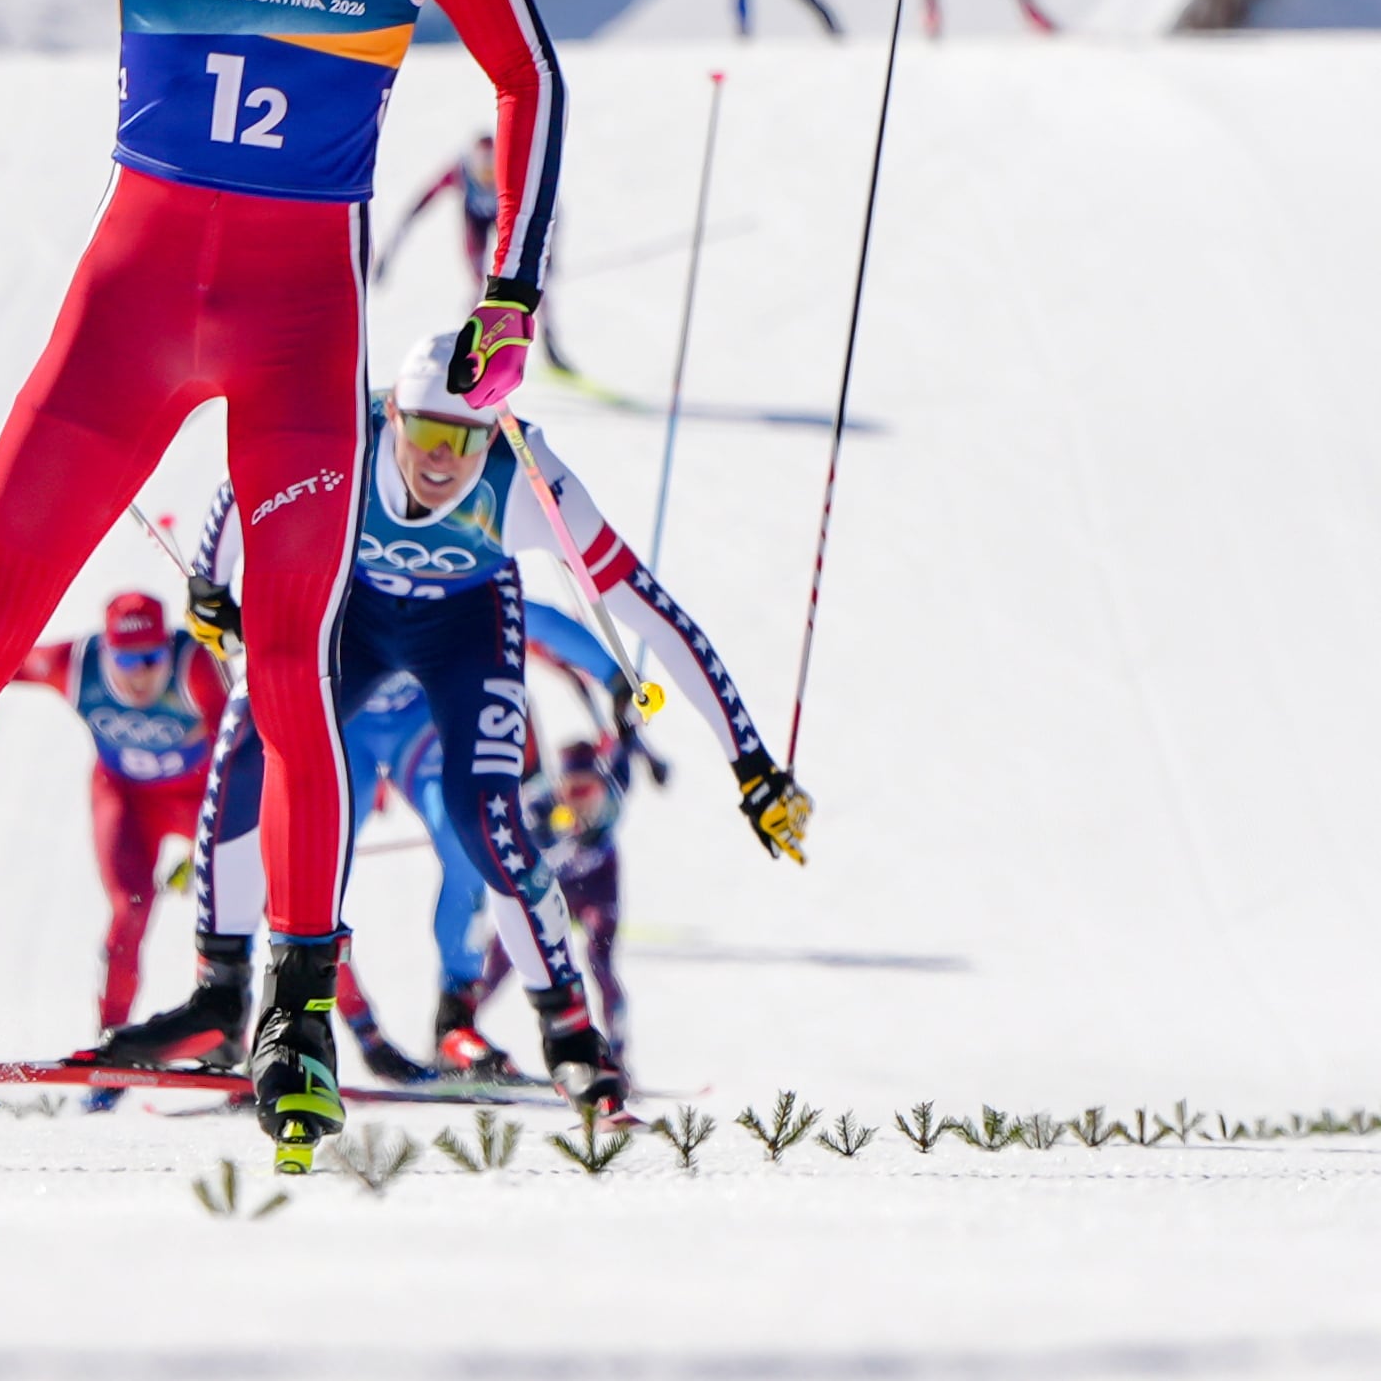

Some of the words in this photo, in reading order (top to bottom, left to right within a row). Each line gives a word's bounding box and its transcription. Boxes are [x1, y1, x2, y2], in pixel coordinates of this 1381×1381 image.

[205, 52, 289, 149] 12
[251, 476, 318, 526] CRAFT
[472, 678, 526, 777] USA
